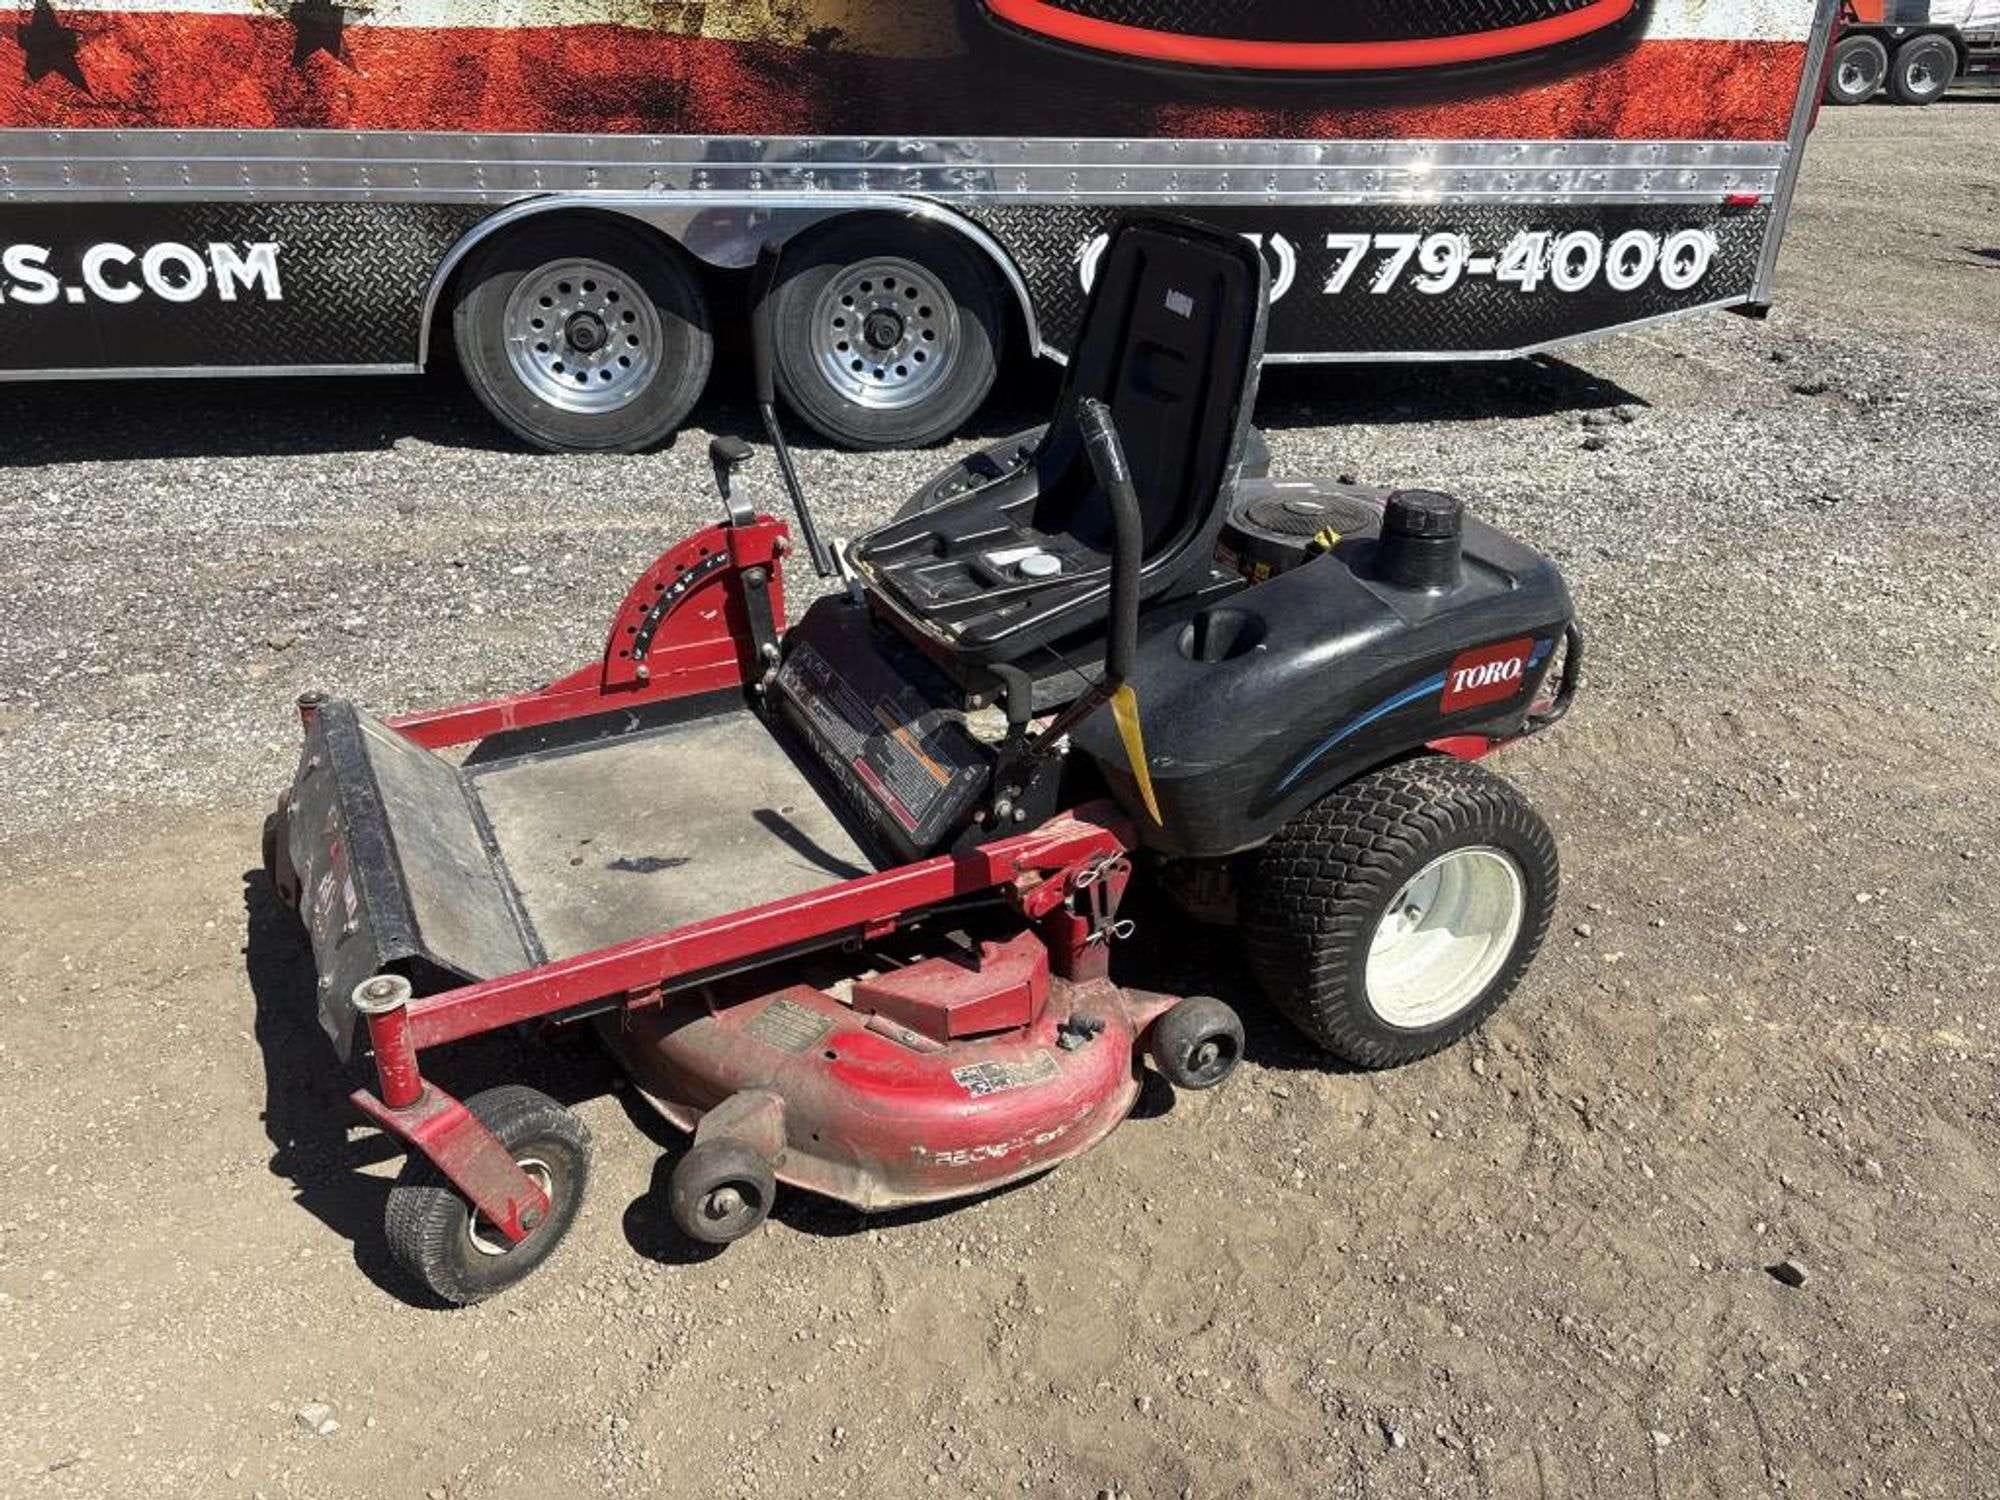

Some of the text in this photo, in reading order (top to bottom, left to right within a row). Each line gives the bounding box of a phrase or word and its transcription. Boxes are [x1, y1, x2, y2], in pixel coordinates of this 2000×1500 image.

[0, 241, 282, 304] S.COM
[1323, 229, 1714, 294] 779-4000
[1453, 657, 1521, 693] TORO
